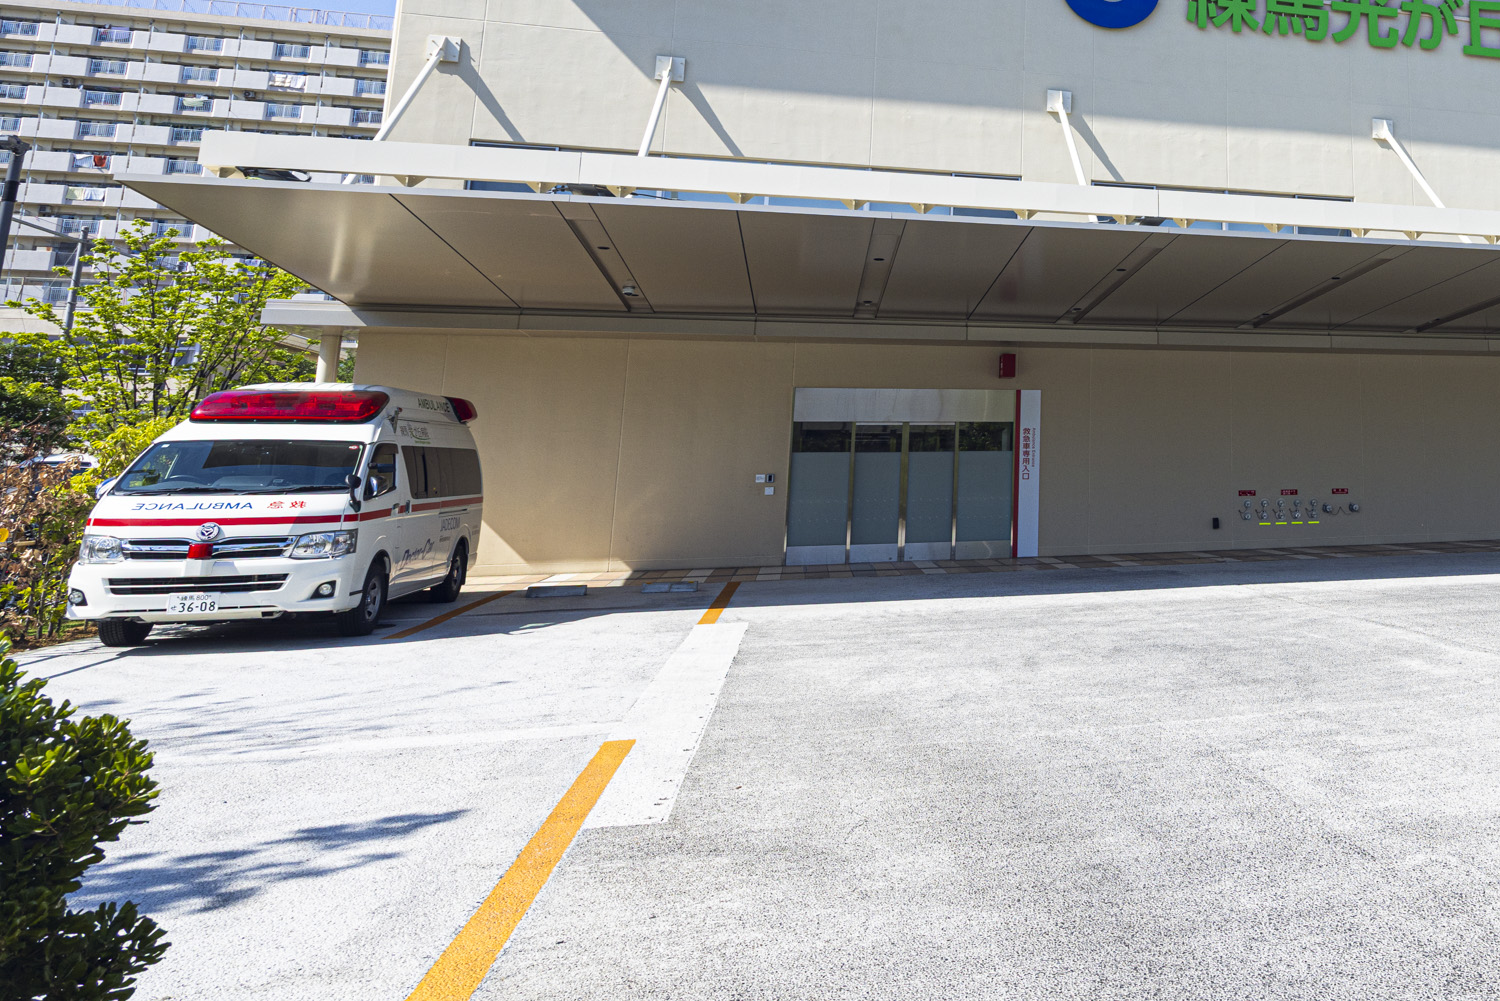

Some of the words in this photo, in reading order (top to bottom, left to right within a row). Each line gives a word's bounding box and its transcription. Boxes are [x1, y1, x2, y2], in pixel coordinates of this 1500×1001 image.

[417, 397, 451, 413] AMBULANCE
[1022, 427, 1031, 480] 救急車専用入口
[178, 601, 216, 613] 36-08
